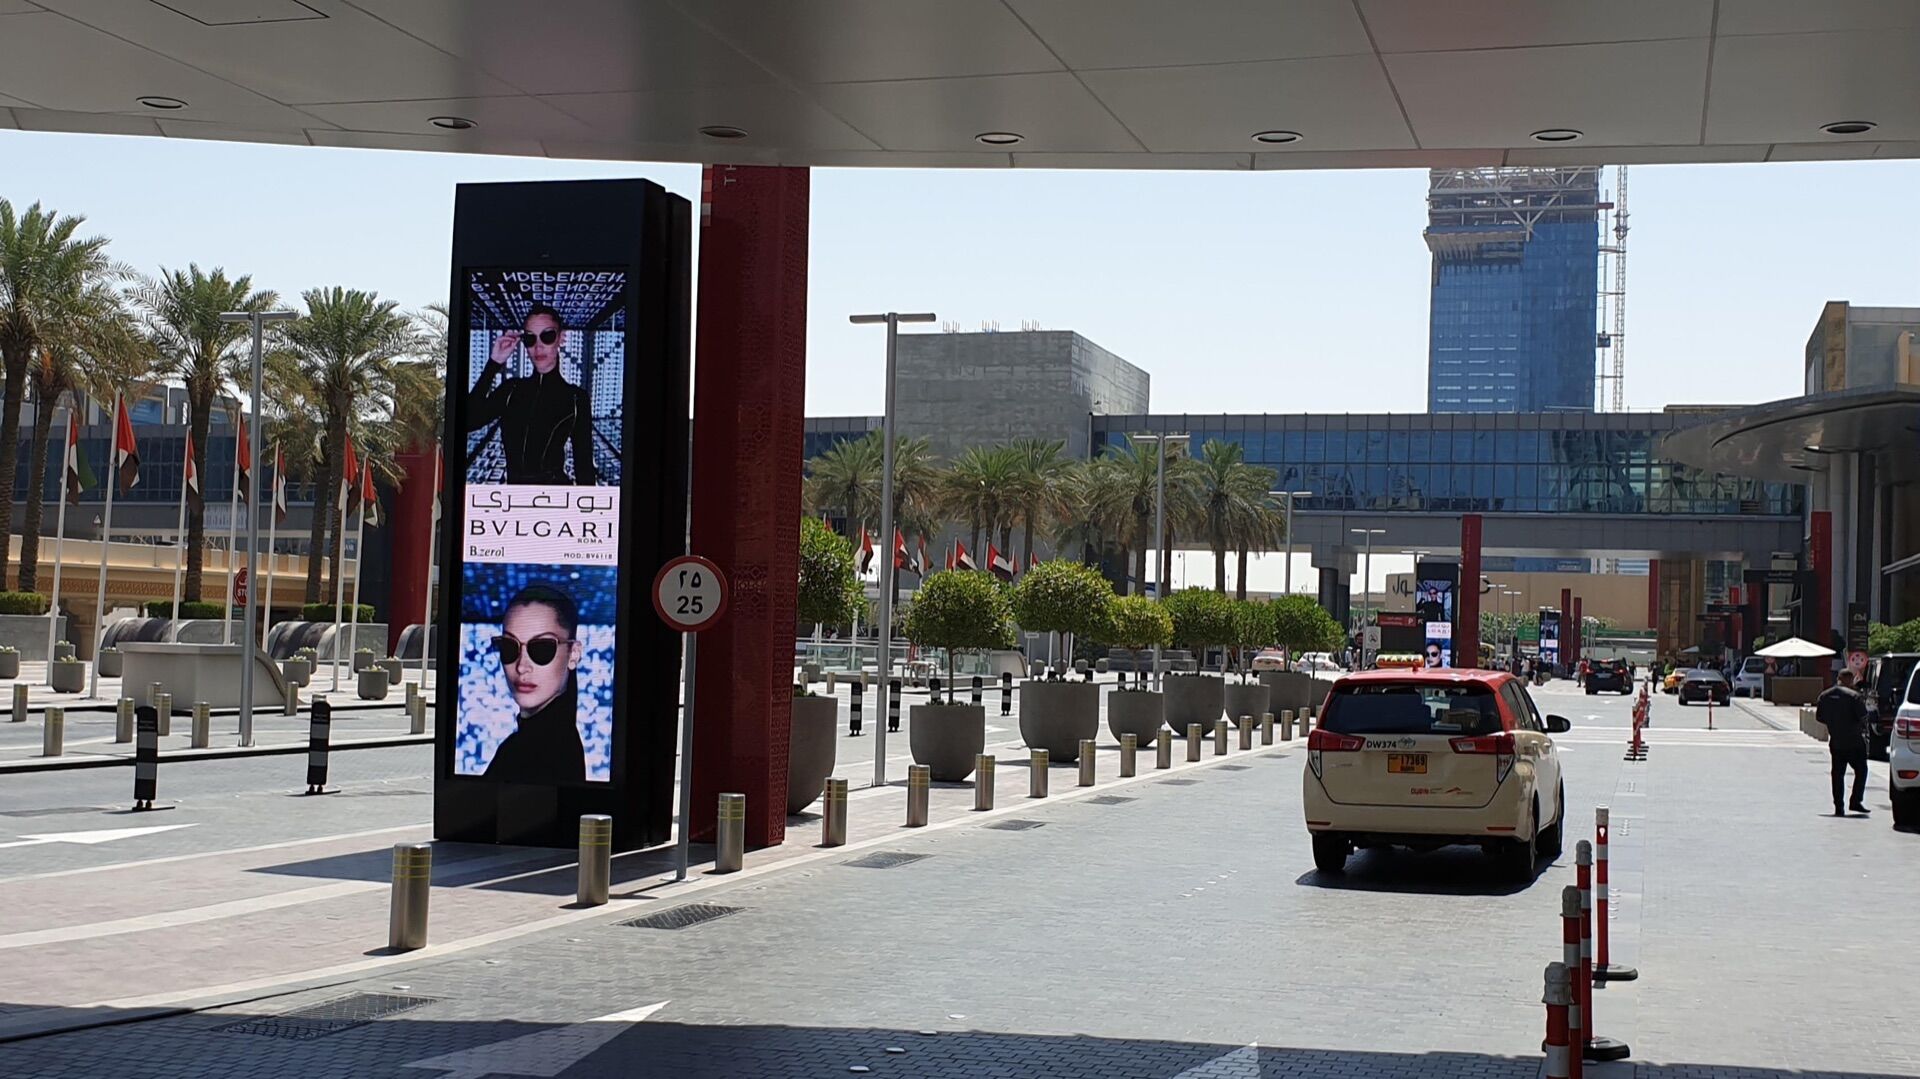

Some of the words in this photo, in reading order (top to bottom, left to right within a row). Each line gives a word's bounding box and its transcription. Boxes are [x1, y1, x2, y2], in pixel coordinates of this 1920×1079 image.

[470, 519, 613, 538] BVLGARI
[679, 570, 702, 589] ٢٥
[677, 595, 703, 614] 25
[1366, 740, 1397, 749] DW374
